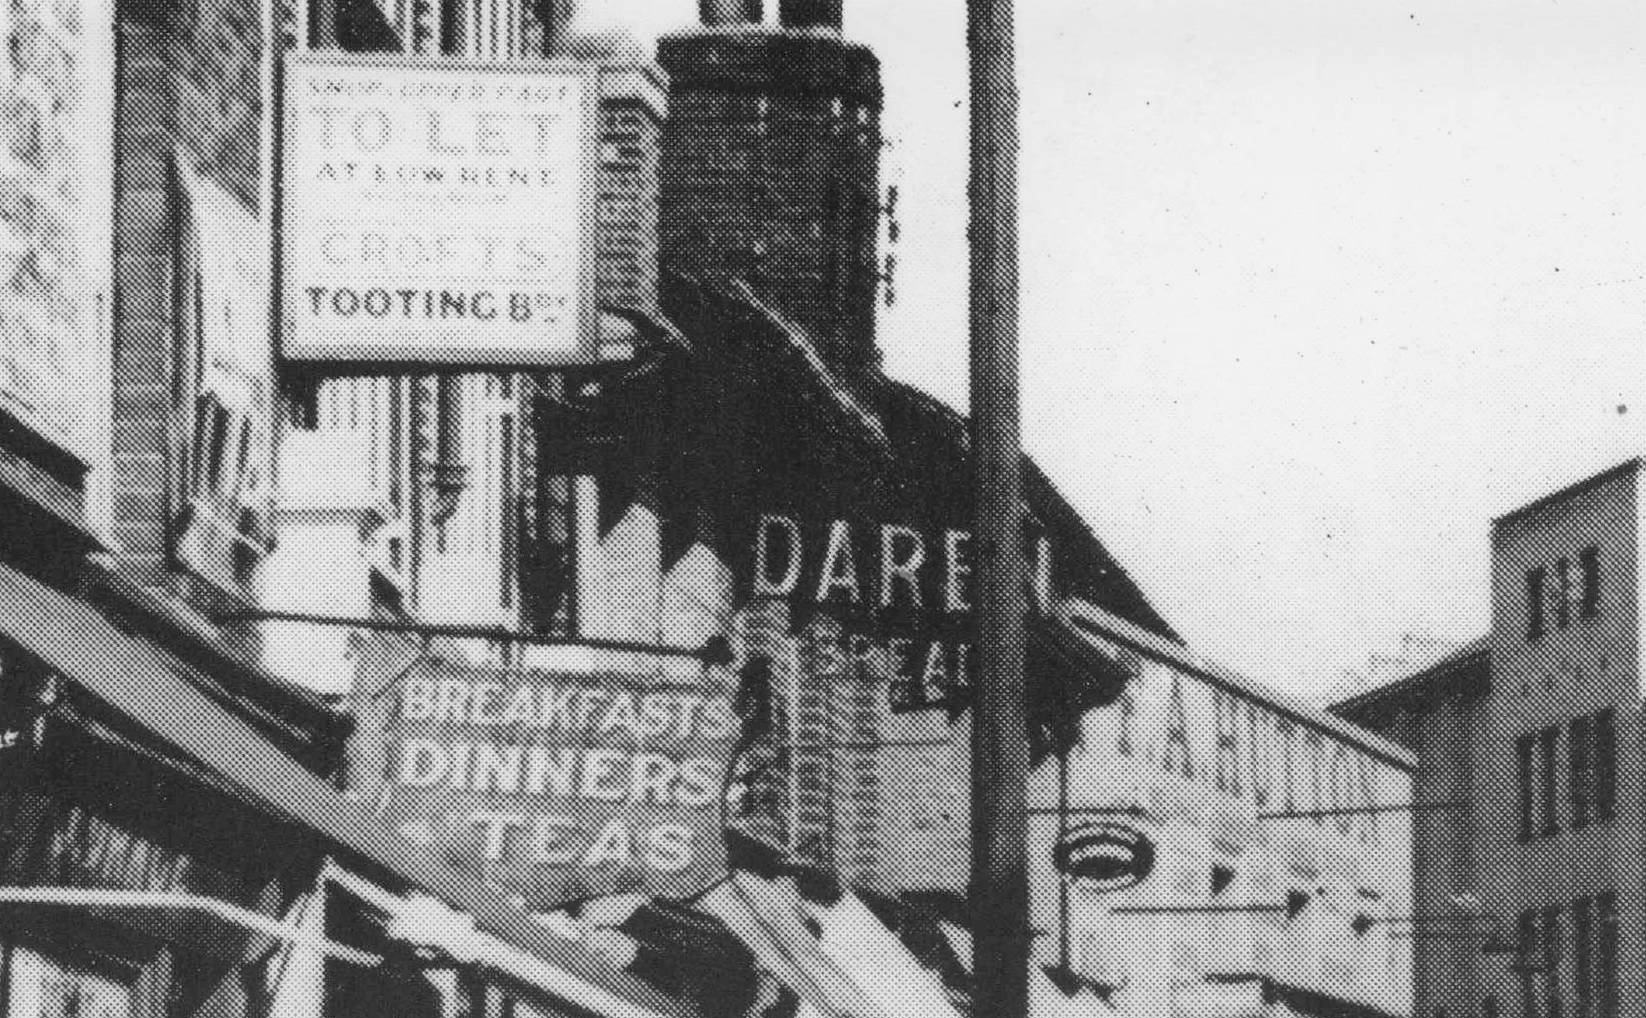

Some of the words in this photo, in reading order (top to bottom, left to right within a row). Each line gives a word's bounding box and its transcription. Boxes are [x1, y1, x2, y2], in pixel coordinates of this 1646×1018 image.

[308, 105, 393, 153] TO
[425, 109, 561, 157] LET
[314, 161, 360, 181] AT
[371, 165, 446, 184] LOW
[456, 166, 558, 188] RENT
[320, 229, 547, 274] CROFTS
[303, 285, 499, 323] TOOTING
[402, 677, 736, 741] BREAKFASTS
[398, 736, 722, 807] DINNERS
[468, 809, 697, 872] TEAS
